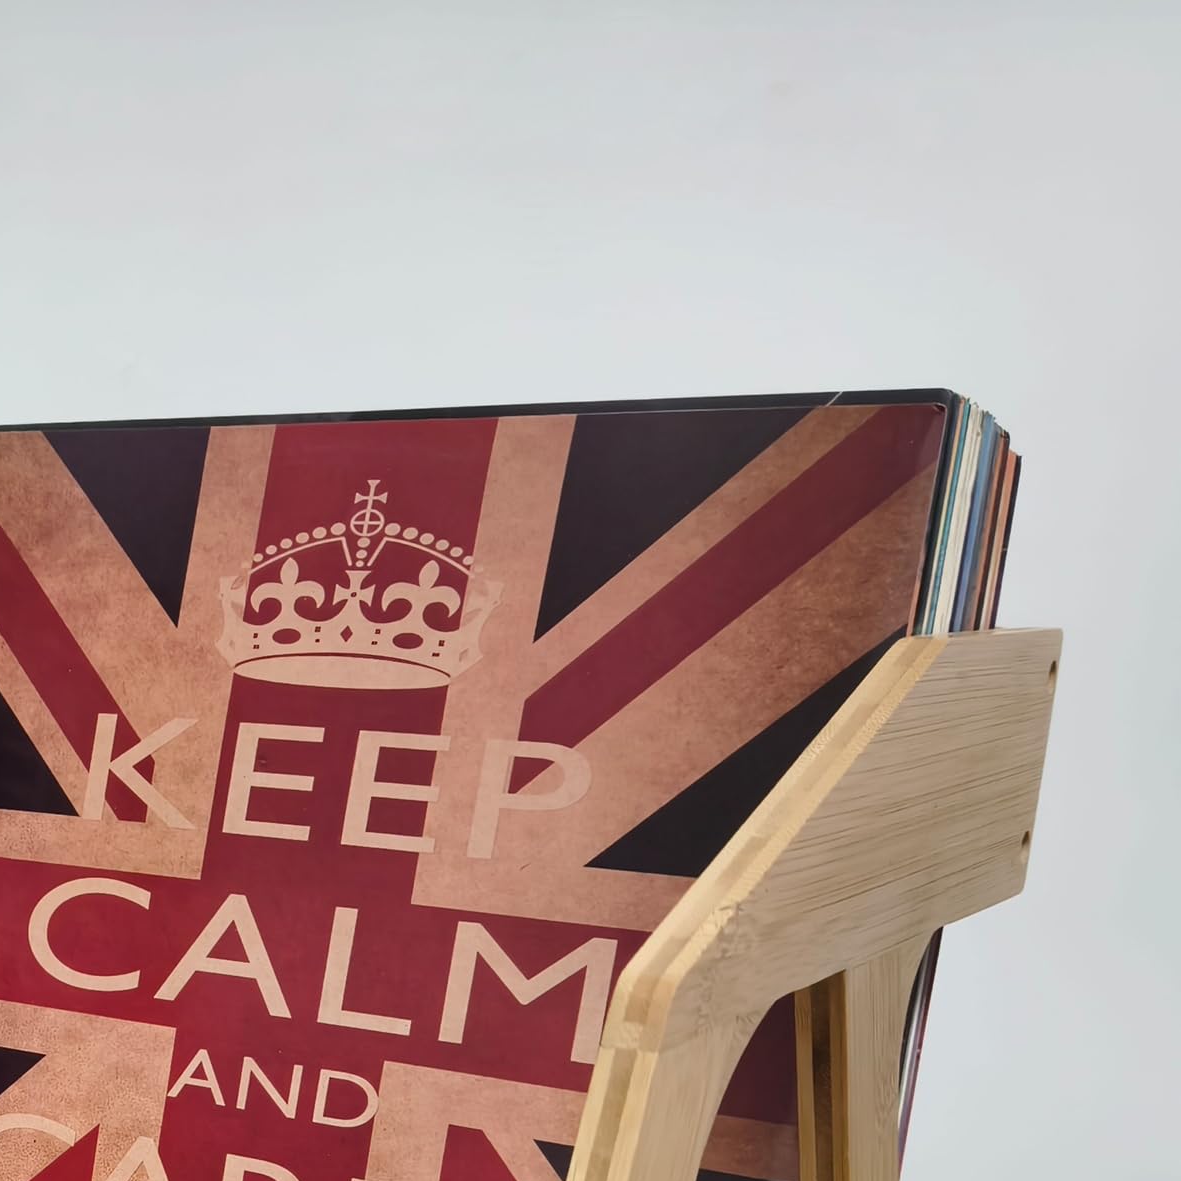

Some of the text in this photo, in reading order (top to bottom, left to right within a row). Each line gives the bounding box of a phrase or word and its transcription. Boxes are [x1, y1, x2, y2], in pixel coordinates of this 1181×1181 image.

[81, 713, 592, 860] KEEP
[27, 876, 618, 1065] CALM
[167, 1049, 379, 1128] AND
